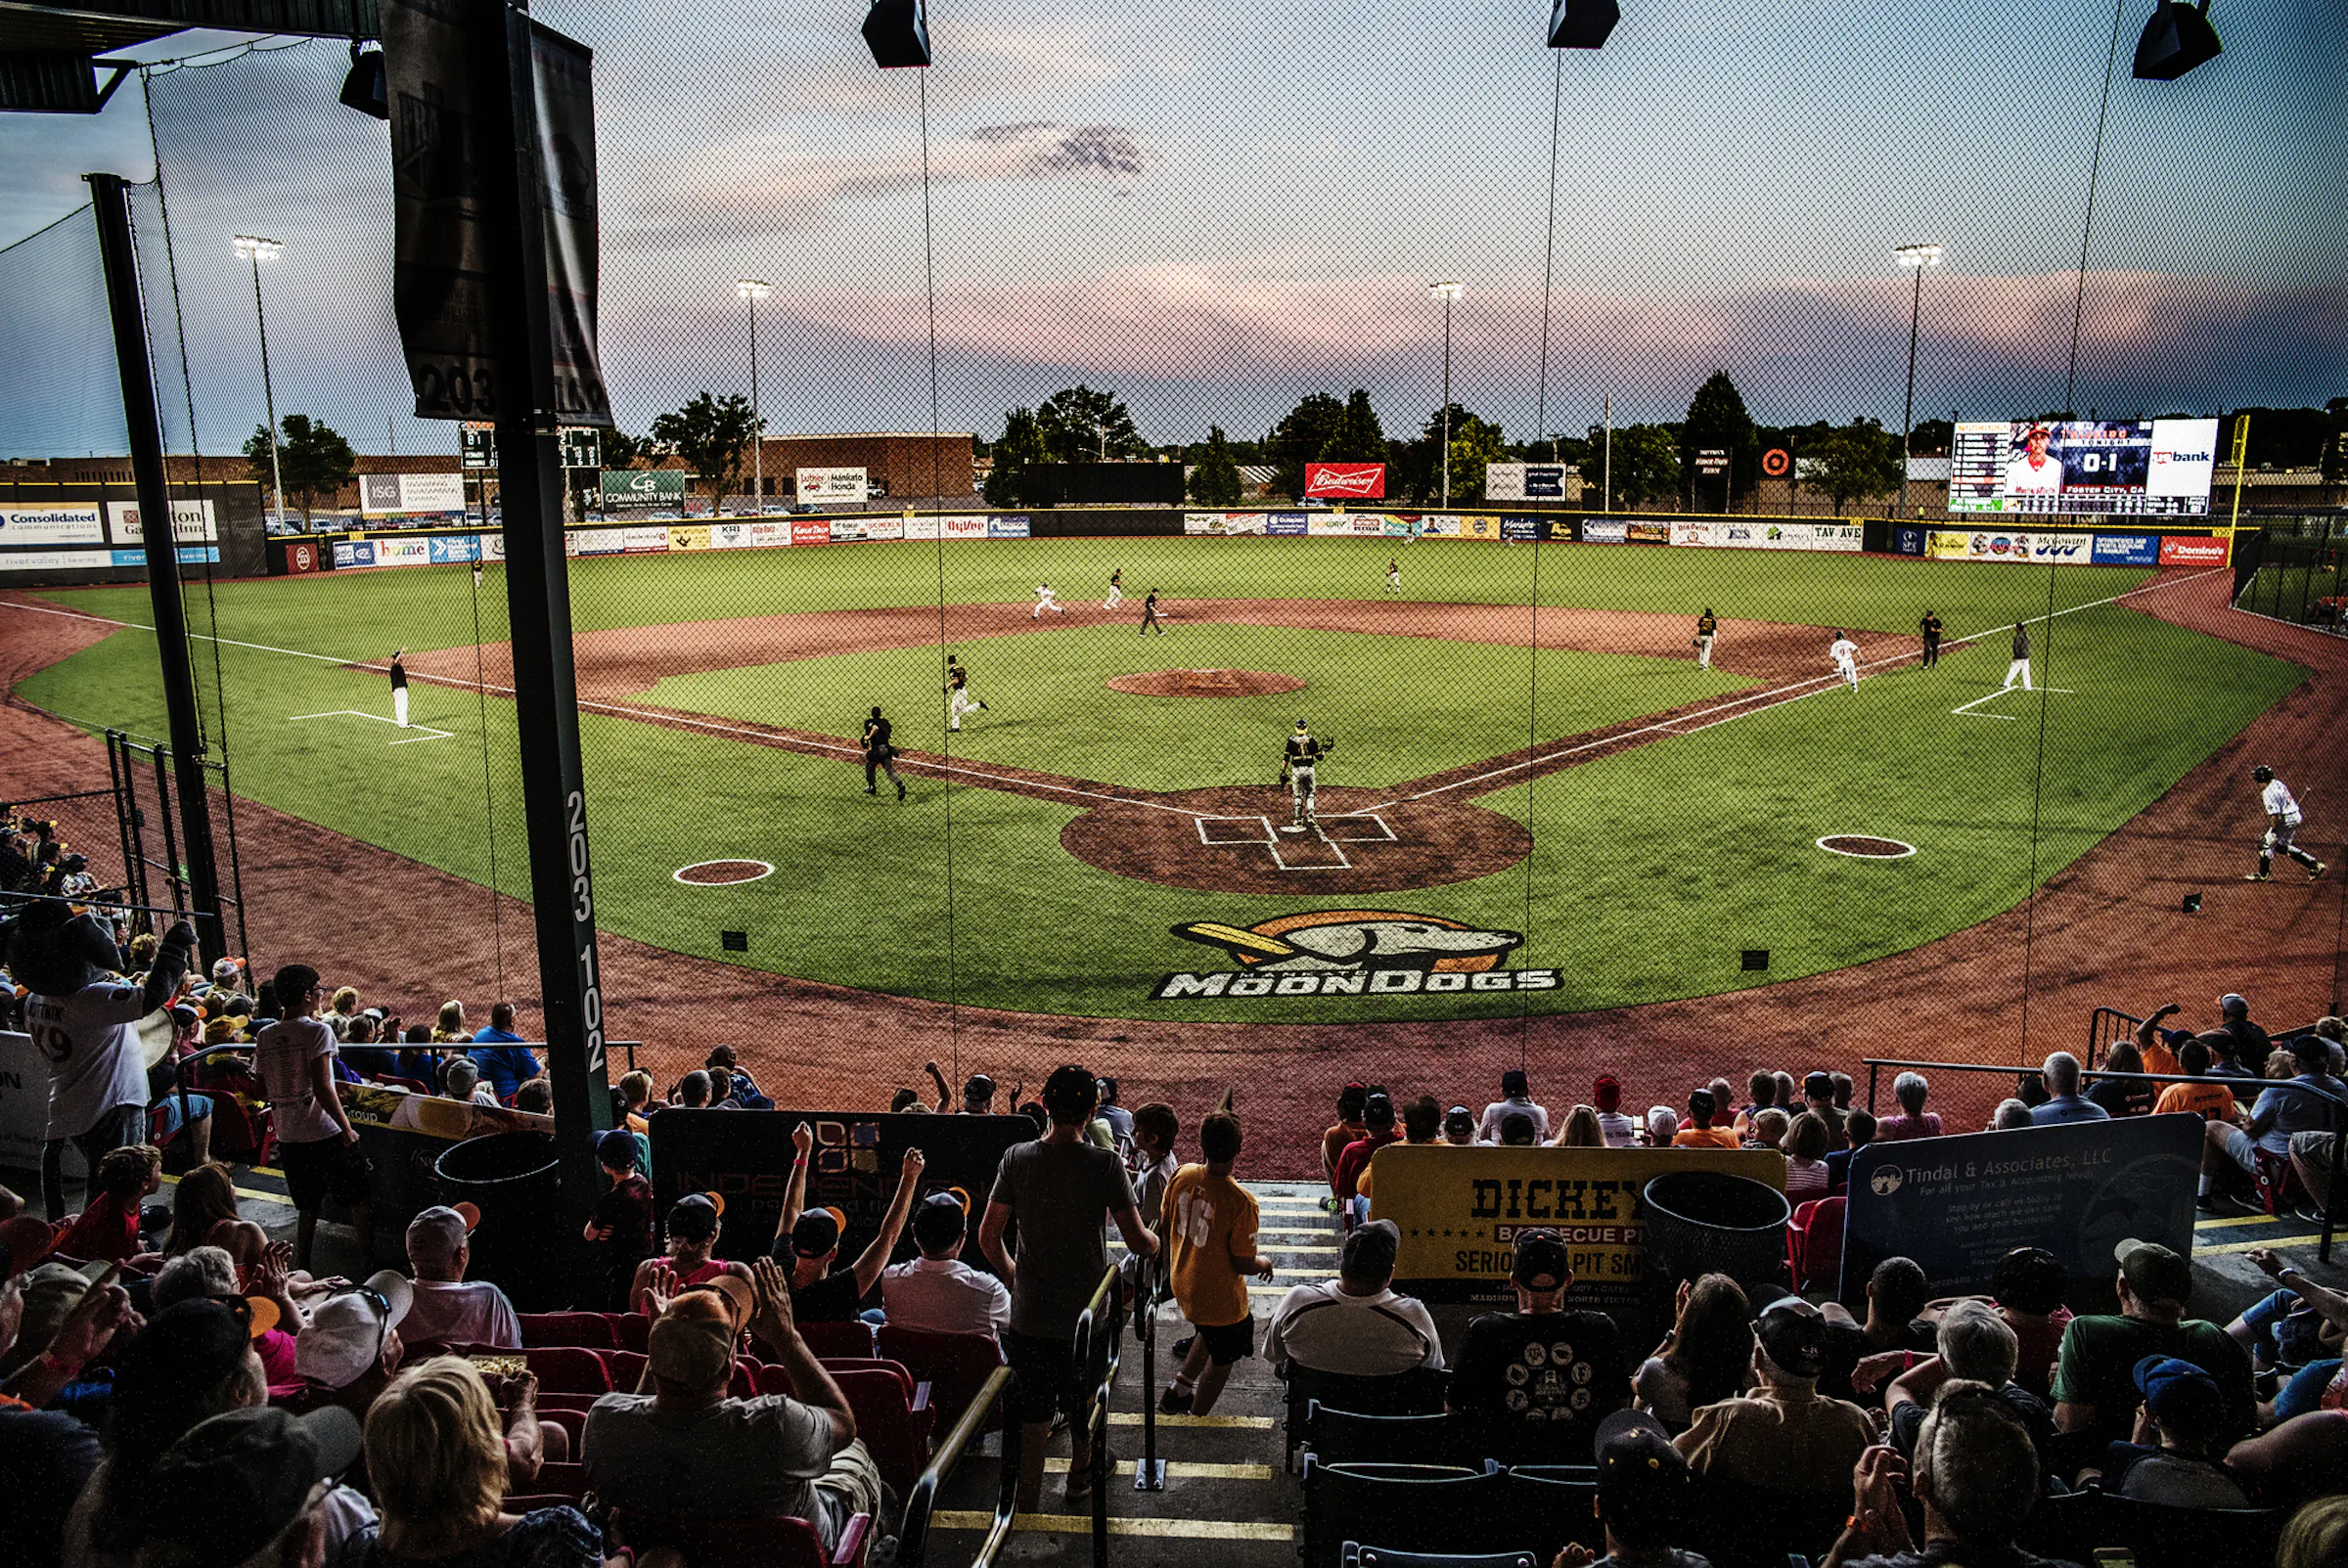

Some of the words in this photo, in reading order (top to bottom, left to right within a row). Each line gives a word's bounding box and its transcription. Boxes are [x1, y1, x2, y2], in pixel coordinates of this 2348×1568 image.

[2173, 451, 2210, 462] bank
[800, 473, 825, 483] Luther
[831, 472, 863, 481] Mankato
[1316, 472, 1375, 487] Budweiser
[371, 486, 397, 499] ISG
[605, 492, 658, 503] COMMUNITY
[659, 491, 682, 501] BANK
[10, 513, 96, 523] Consolidated
[1815, 527, 1835, 537] TAV
[1840, 528, 1862, 538] AVE
[381, 540, 425, 557] home
[2178, 545, 2224, 555] Domino's
[566, 789, 592, 922] 203
[1159, 969, 1558, 999] MOONDOGS
[579, 944, 604, 1073] 102
[1906, 1165, 1959, 1185] Tindal
[1964, 1161, 1976, 1178] &
[1983, 1152, 2076, 1176] Associates,
[2082, 1147, 2113, 1166] LLC
[1919, 1187, 1936, 1196] For
[1980, 1180, 1996, 1189] Tax
[1470, 1179, 1646, 1220] DICKEY
[1177, 1191, 1215, 1249] 16
[1498, 1226, 1616, 1242] BECUE
[1456, 1250, 1513, 1273] SERIO
[1572, 1252, 1605, 1273] PIT
[1603, 1295, 1641, 1305] VICTOR
